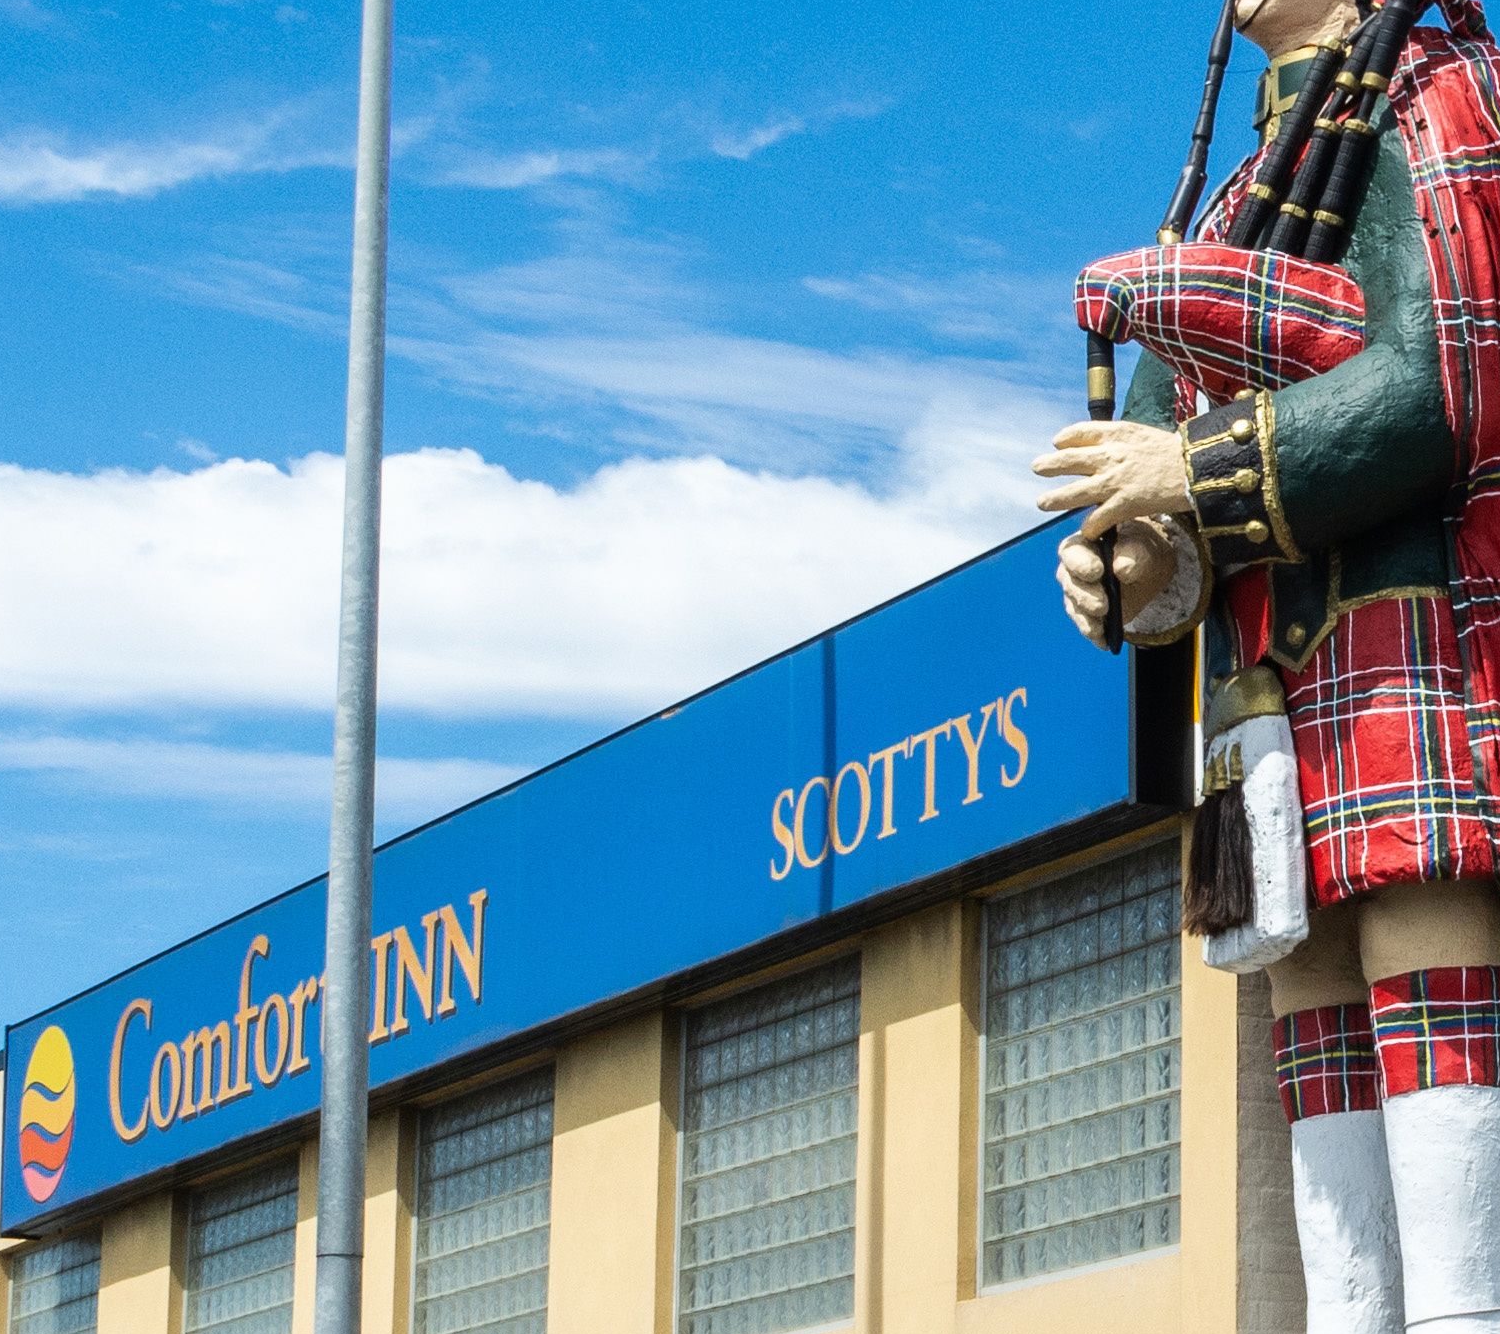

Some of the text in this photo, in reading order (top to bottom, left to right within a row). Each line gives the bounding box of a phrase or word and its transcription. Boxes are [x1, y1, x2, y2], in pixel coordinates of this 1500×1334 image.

[769, 686, 1029, 882] SCOTTY'S
[108, 887, 489, 1142] Comfor INN
